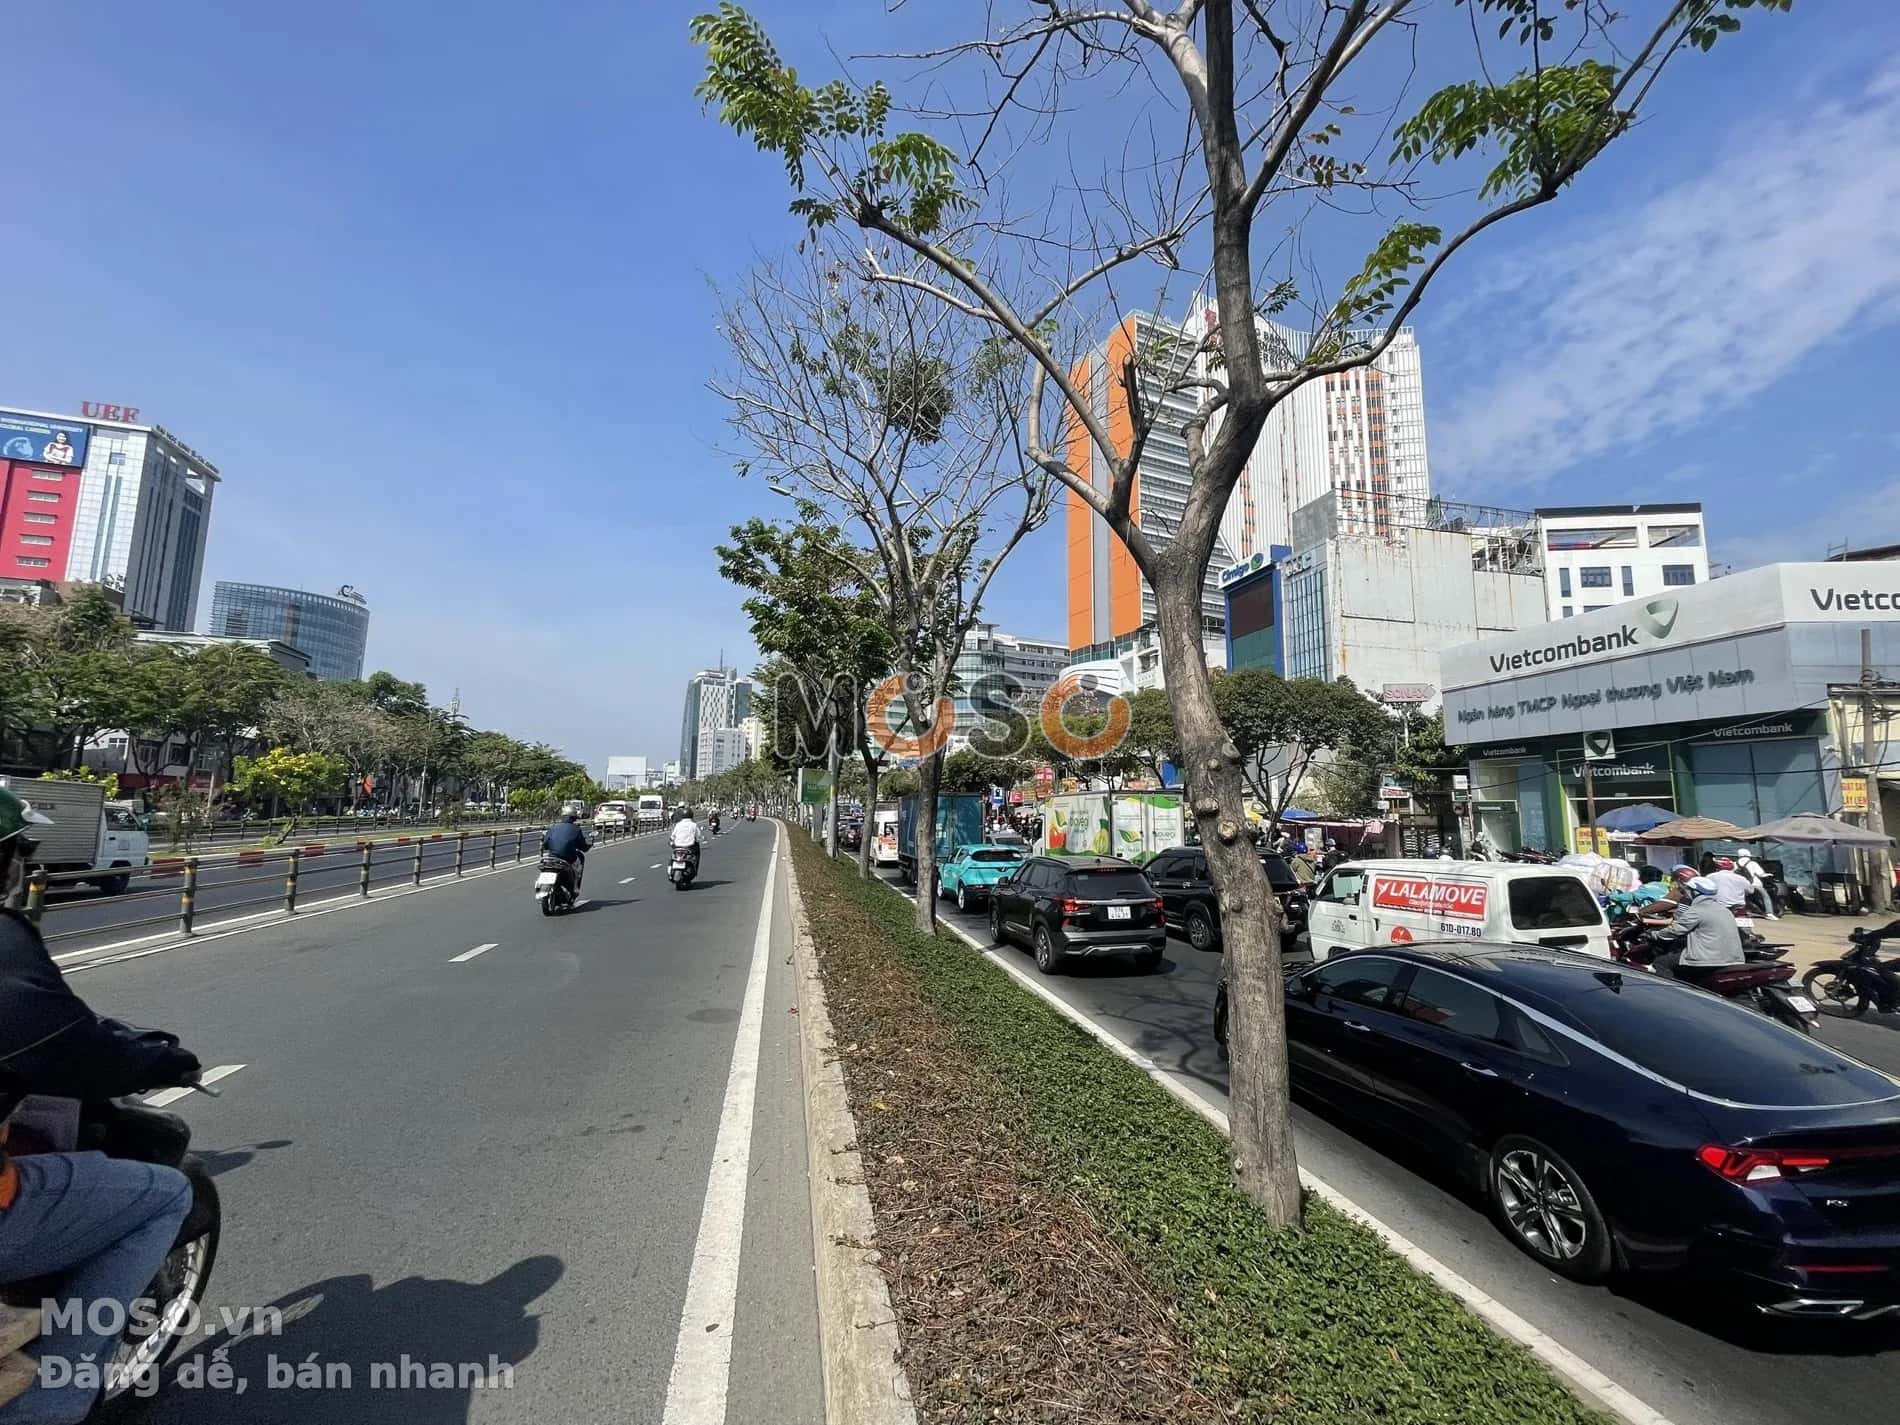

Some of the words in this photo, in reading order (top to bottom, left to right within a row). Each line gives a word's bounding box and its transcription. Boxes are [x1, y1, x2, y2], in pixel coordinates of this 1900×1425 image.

[82, 401, 139, 422] UEF
[1490, 625, 1640, 673] Vietcombank
[1517, 696, 1557, 715] TMCP
[1666, 674, 1704, 695] Việt
[1708, 669, 1754, 690] Nam
[1713, 722, 1793, 737] Vietcombank
[1572, 762, 1656, 778] Vitcombank
[1389, 881, 1486, 905] LALAMOVE
